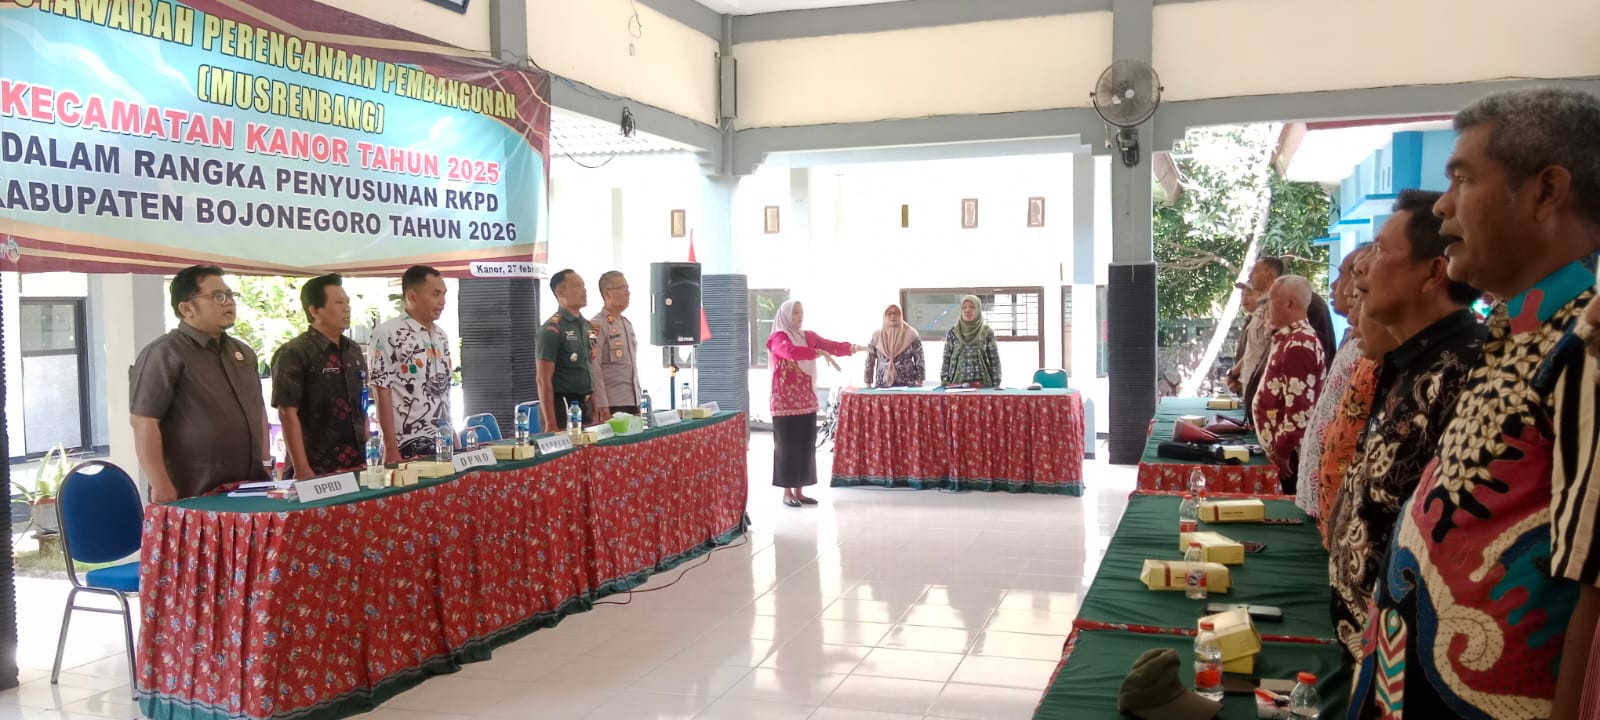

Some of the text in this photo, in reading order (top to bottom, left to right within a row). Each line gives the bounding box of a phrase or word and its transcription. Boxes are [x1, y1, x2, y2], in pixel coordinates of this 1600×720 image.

[13, 0, 516, 119] AWARAH PERENCANAAN PEMBANGUNAN
[1, 80, 500, 184] KECAMATAN KANOR TAHUN 2025
[197, 64, 385, 134] (MUSRENBANG)
[1, 131, 499, 213] DALAM RANGKA PENYUSUNAN RKPD
[196, 197, 381, 236] BOJONEGORO
[389, 215, 461, 240] TAHUN
[468, 221, 517, 242] 2026
[476, 264, 505, 275] Kanor,
[507, 264, 517, 274] 27
[313, 480, 342, 494] DPRD
